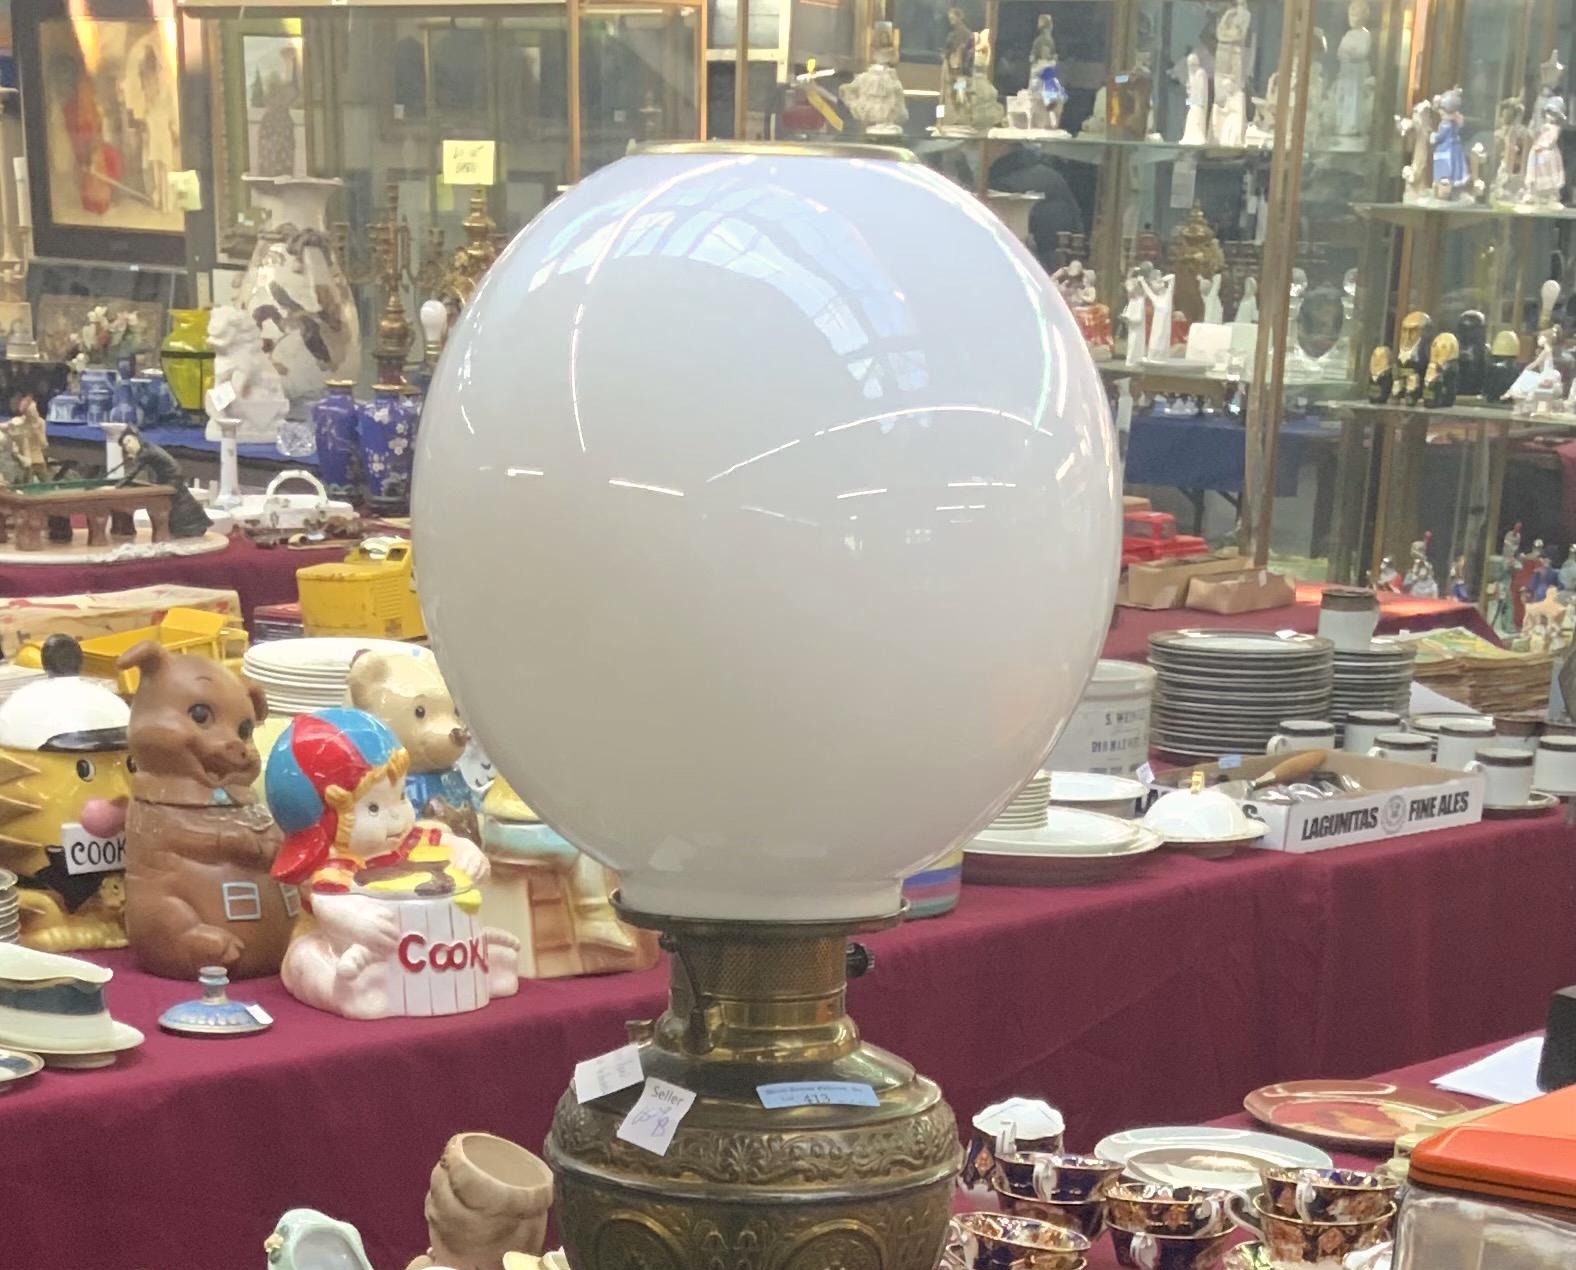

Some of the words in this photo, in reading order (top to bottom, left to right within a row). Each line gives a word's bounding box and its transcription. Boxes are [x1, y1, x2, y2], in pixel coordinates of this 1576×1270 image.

[1301, 806, 1379, 841] LAGUNITAS
[1408, 797, 1437, 822] FINE
[1437, 790, 1470, 818] ALES
[650, 1084, 685, 1107] Seller
